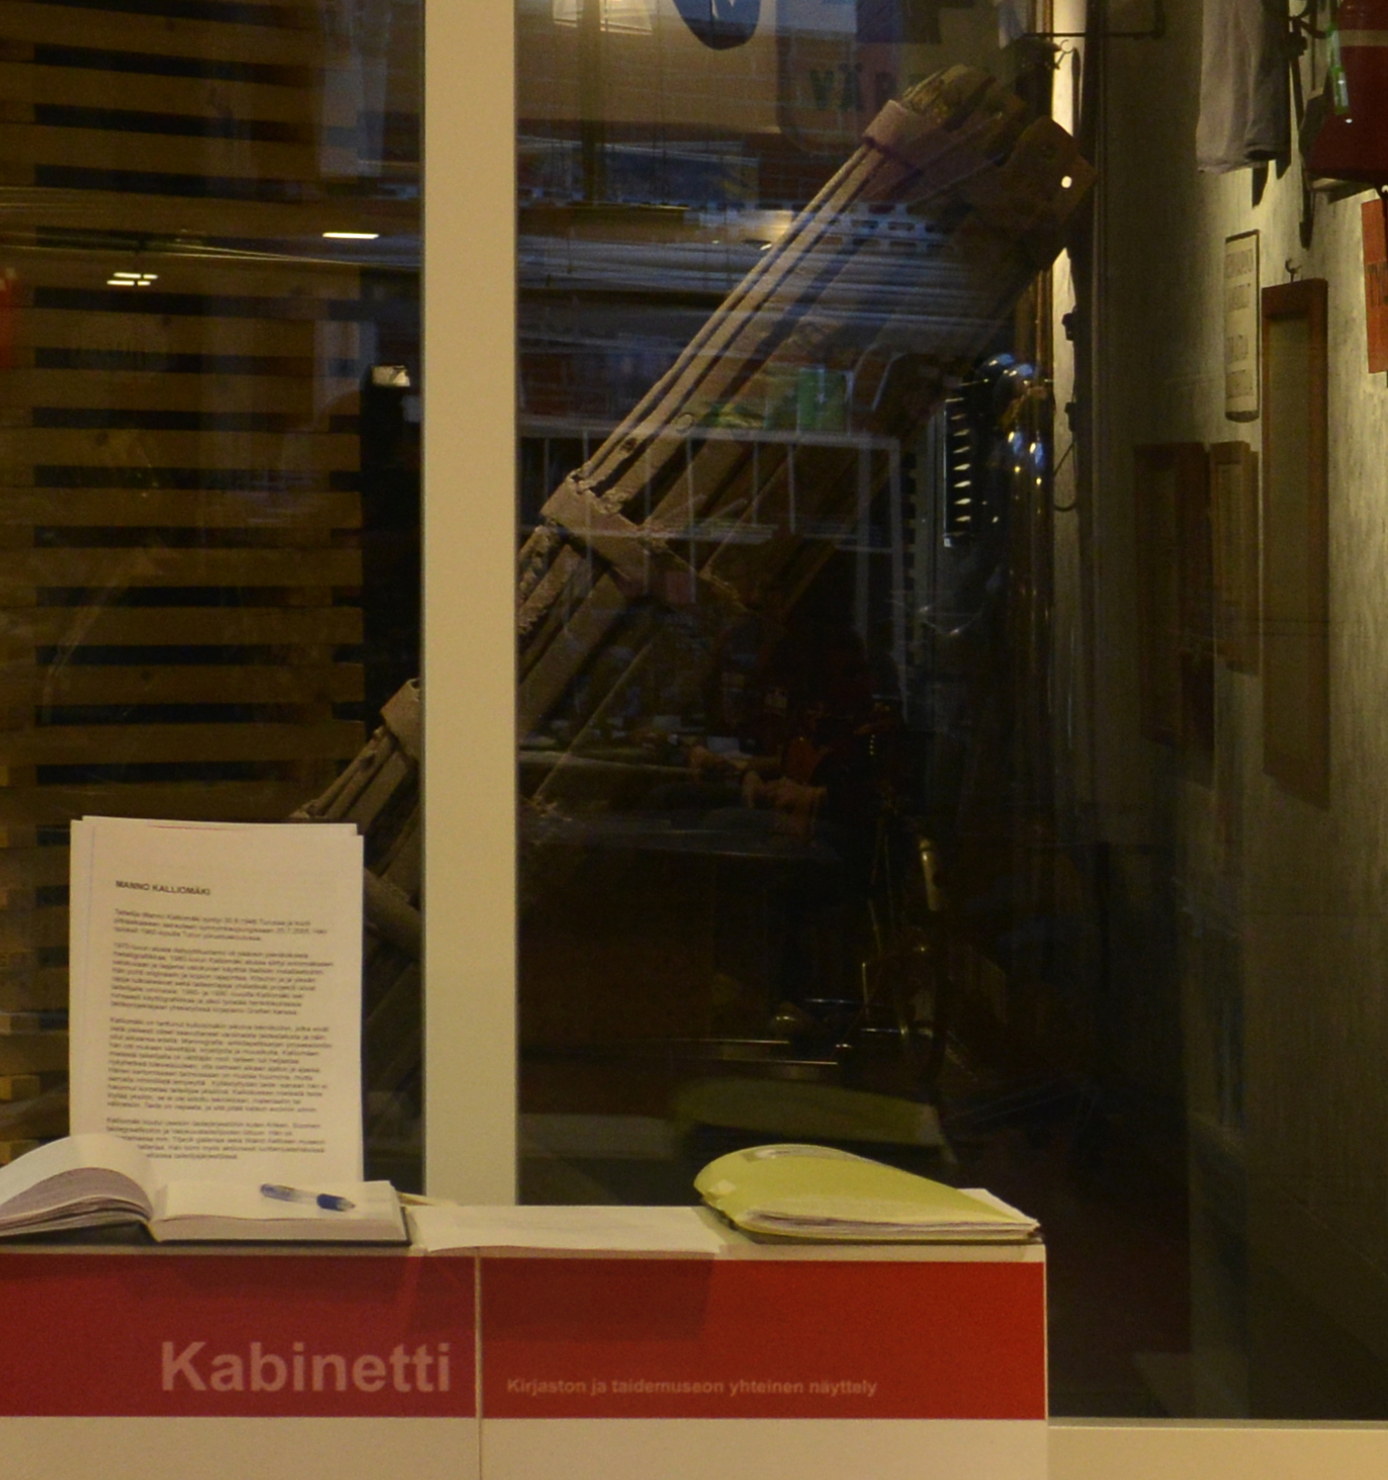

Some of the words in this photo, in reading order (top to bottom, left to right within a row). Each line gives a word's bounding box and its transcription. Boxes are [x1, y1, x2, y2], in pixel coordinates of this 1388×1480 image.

[162, 1341, 450, 1392] Kabinetti
[507, 1378, 586, 1395] Kirjaston
[591, 1379, 606, 1396] ja
[612, 1379, 724, 1394] taidemuseon
[730, 1379, 803, 1396] yhteinen
[809, 1379, 877, 1396] näyttely
